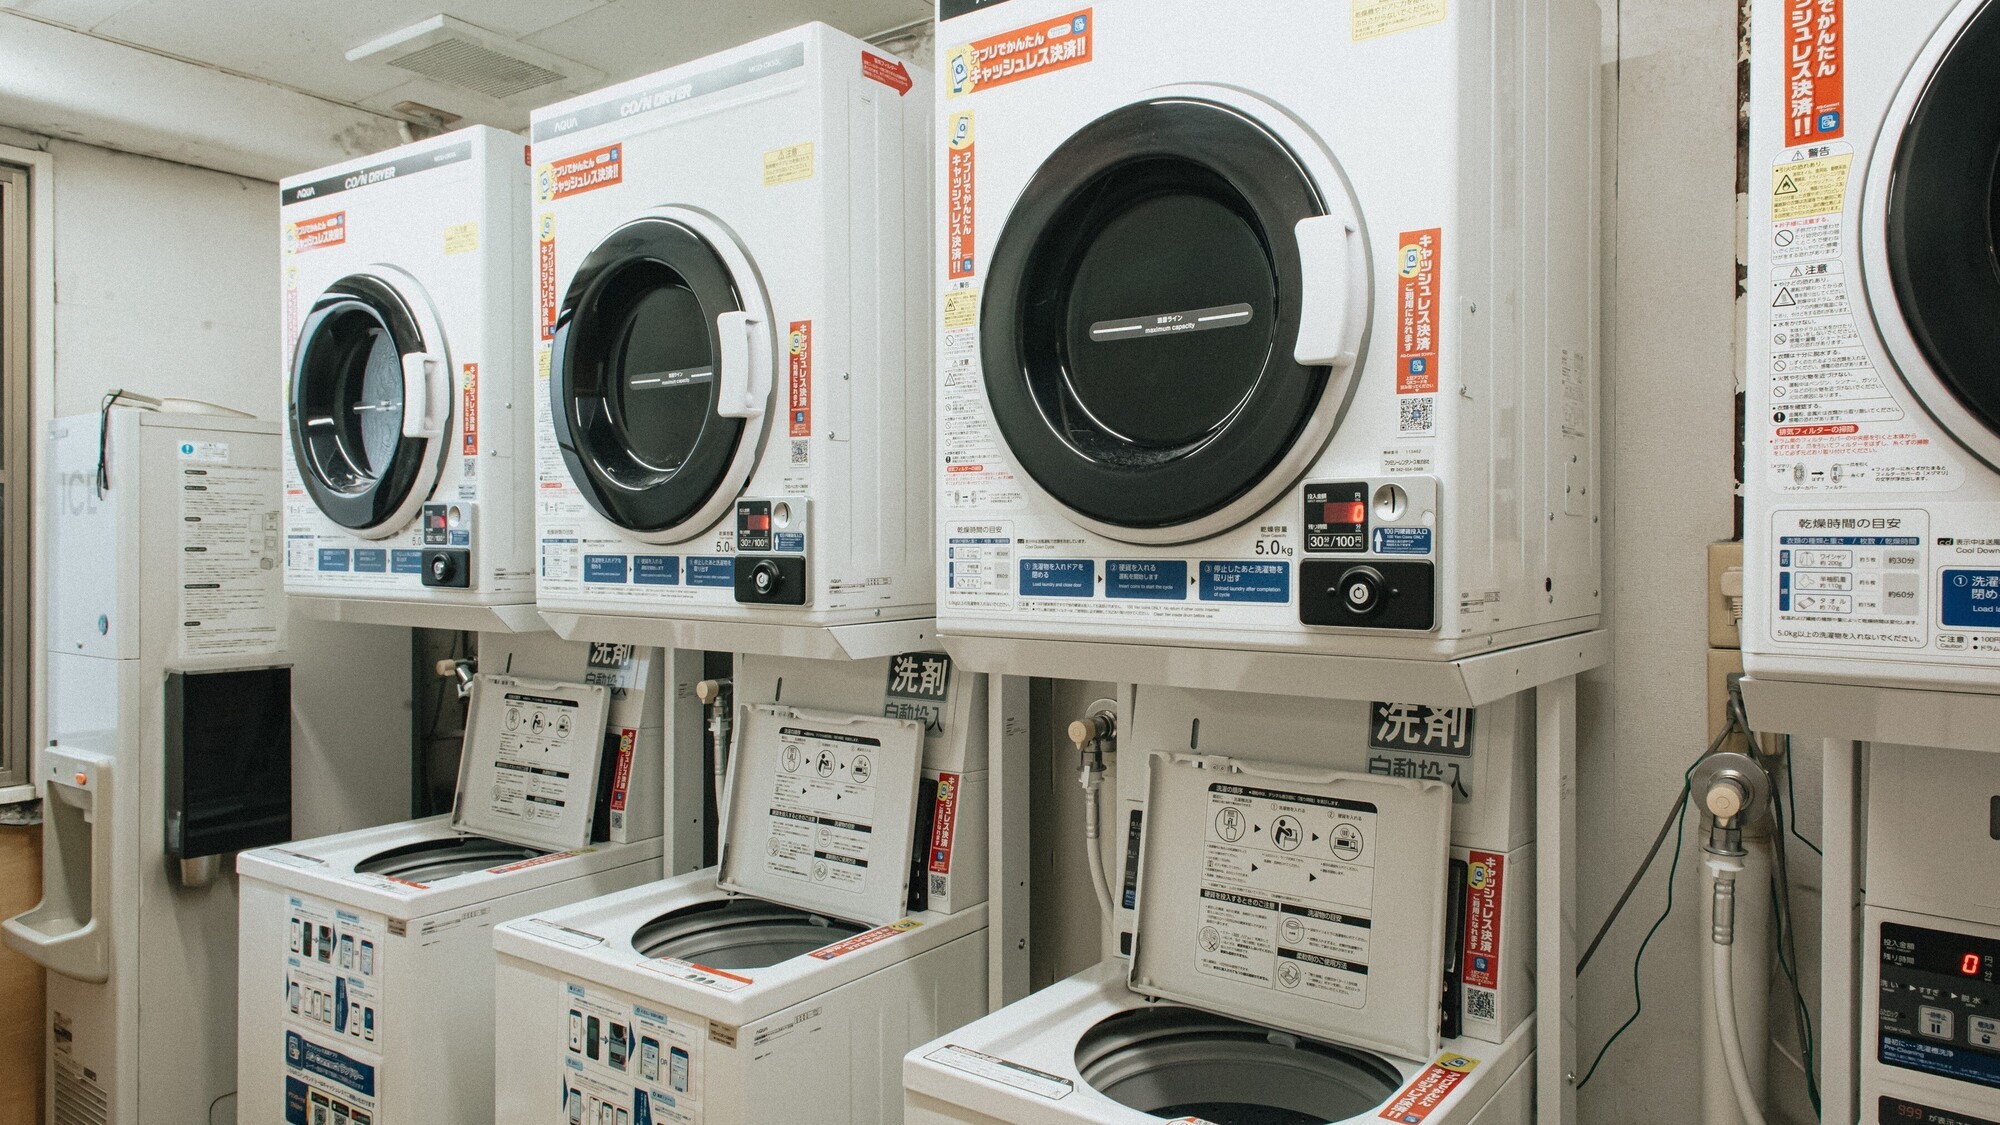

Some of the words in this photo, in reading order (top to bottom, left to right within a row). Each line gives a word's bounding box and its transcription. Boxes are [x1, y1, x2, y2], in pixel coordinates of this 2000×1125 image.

[971, 32, 1044, 64] アプリでかんたん
[970, 37, 1086, 84] キャッシュレス決済!!
[653, 84, 692, 108] DRYER
[555, 117, 578, 132] AQUA
[1808, 146, 1830, 158] 警告
[369, 167, 396, 183] DRYER
[552, 158, 595, 178] アプリでかんたん
[552, 164, 619, 193] キャッシュレス決済!!
[296, 187, 315, 199] AQUA
[962, 152, 972, 236] アプリでかんたん
[951, 154, 962, 274] キャッシュレス決済!!
[1779, 217, 1830, 228] お子様に注意する。
[1805, 264, 1828, 275] 注意
[1779, 277, 1829, 287] やけどの恐れあり。
[1417, 234, 1432, 350] キャッシュレス決済
[1404, 283, 1414, 352] ご利用になれます
[1145, 326, 1171, 334] maximum
[1172, 321, 1196, 332] capacity
[1778, 350, 1841, 360] 衣類は十分に脱水する。
[799, 324, 808, 407] キャッシュレス決済
[1777, 372, 1853, 381] 火気や引火物を近づけない。
[1777, 403, 1822, 411] 衣類を確認する。
[1779, 425, 1855, 435] 排気フィルターの掃除
[1353, 503, 1364, 523] 0
[1798, 518, 1902, 530] 乾燥時間の目安
[716, 541, 730, 552] 5.0
[1255, 540, 1280, 555] 5.0
[1281, 546, 1293, 556] kg
[1032, 563, 1084, 571] 洗濯物を入れドアを
[1118, 564, 1156, 572] 硬貨を入れる
[1213, 565, 1284, 574] 停止したあと洗濯物を
[1032, 571, 1049, 579] 閉める
[1213, 575, 1240, 583] 取り出す
[1953, 574, 1968, 587] ①
[1971, 576, 2000, 588] 洗濯
[1777, 630, 1920, 642] 5.0kg以上の洗濯物を入れないでください。
[891, 656, 948, 696] 洗剤
[1376, 702, 1466, 750] 洗剤
[940, 776, 955, 848] キャッシュレス決済
[1204, 891, 1275, 910] 硬貨を投入するときのご注意
[1480, 857, 1497, 952] キャッシュレス決済
[1307, 909, 1343, 923] 洗濯物の目安
[1470, 893, 1481, 950] ご利用になれます
[1883, 938, 1915, 950] 投入金額
[1883, 952, 1915, 965] 残り時間
[1962, 954, 1979, 973] 0
[1984, 955, 1993, 964] 円
[1984, 970, 1993, 979] 分
[1919, 986, 1939, 997] すすぎ
[1883, 1044, 1925, 1059] Pre-Cleaning
[1898, 1104, 1923, 1120] 999
